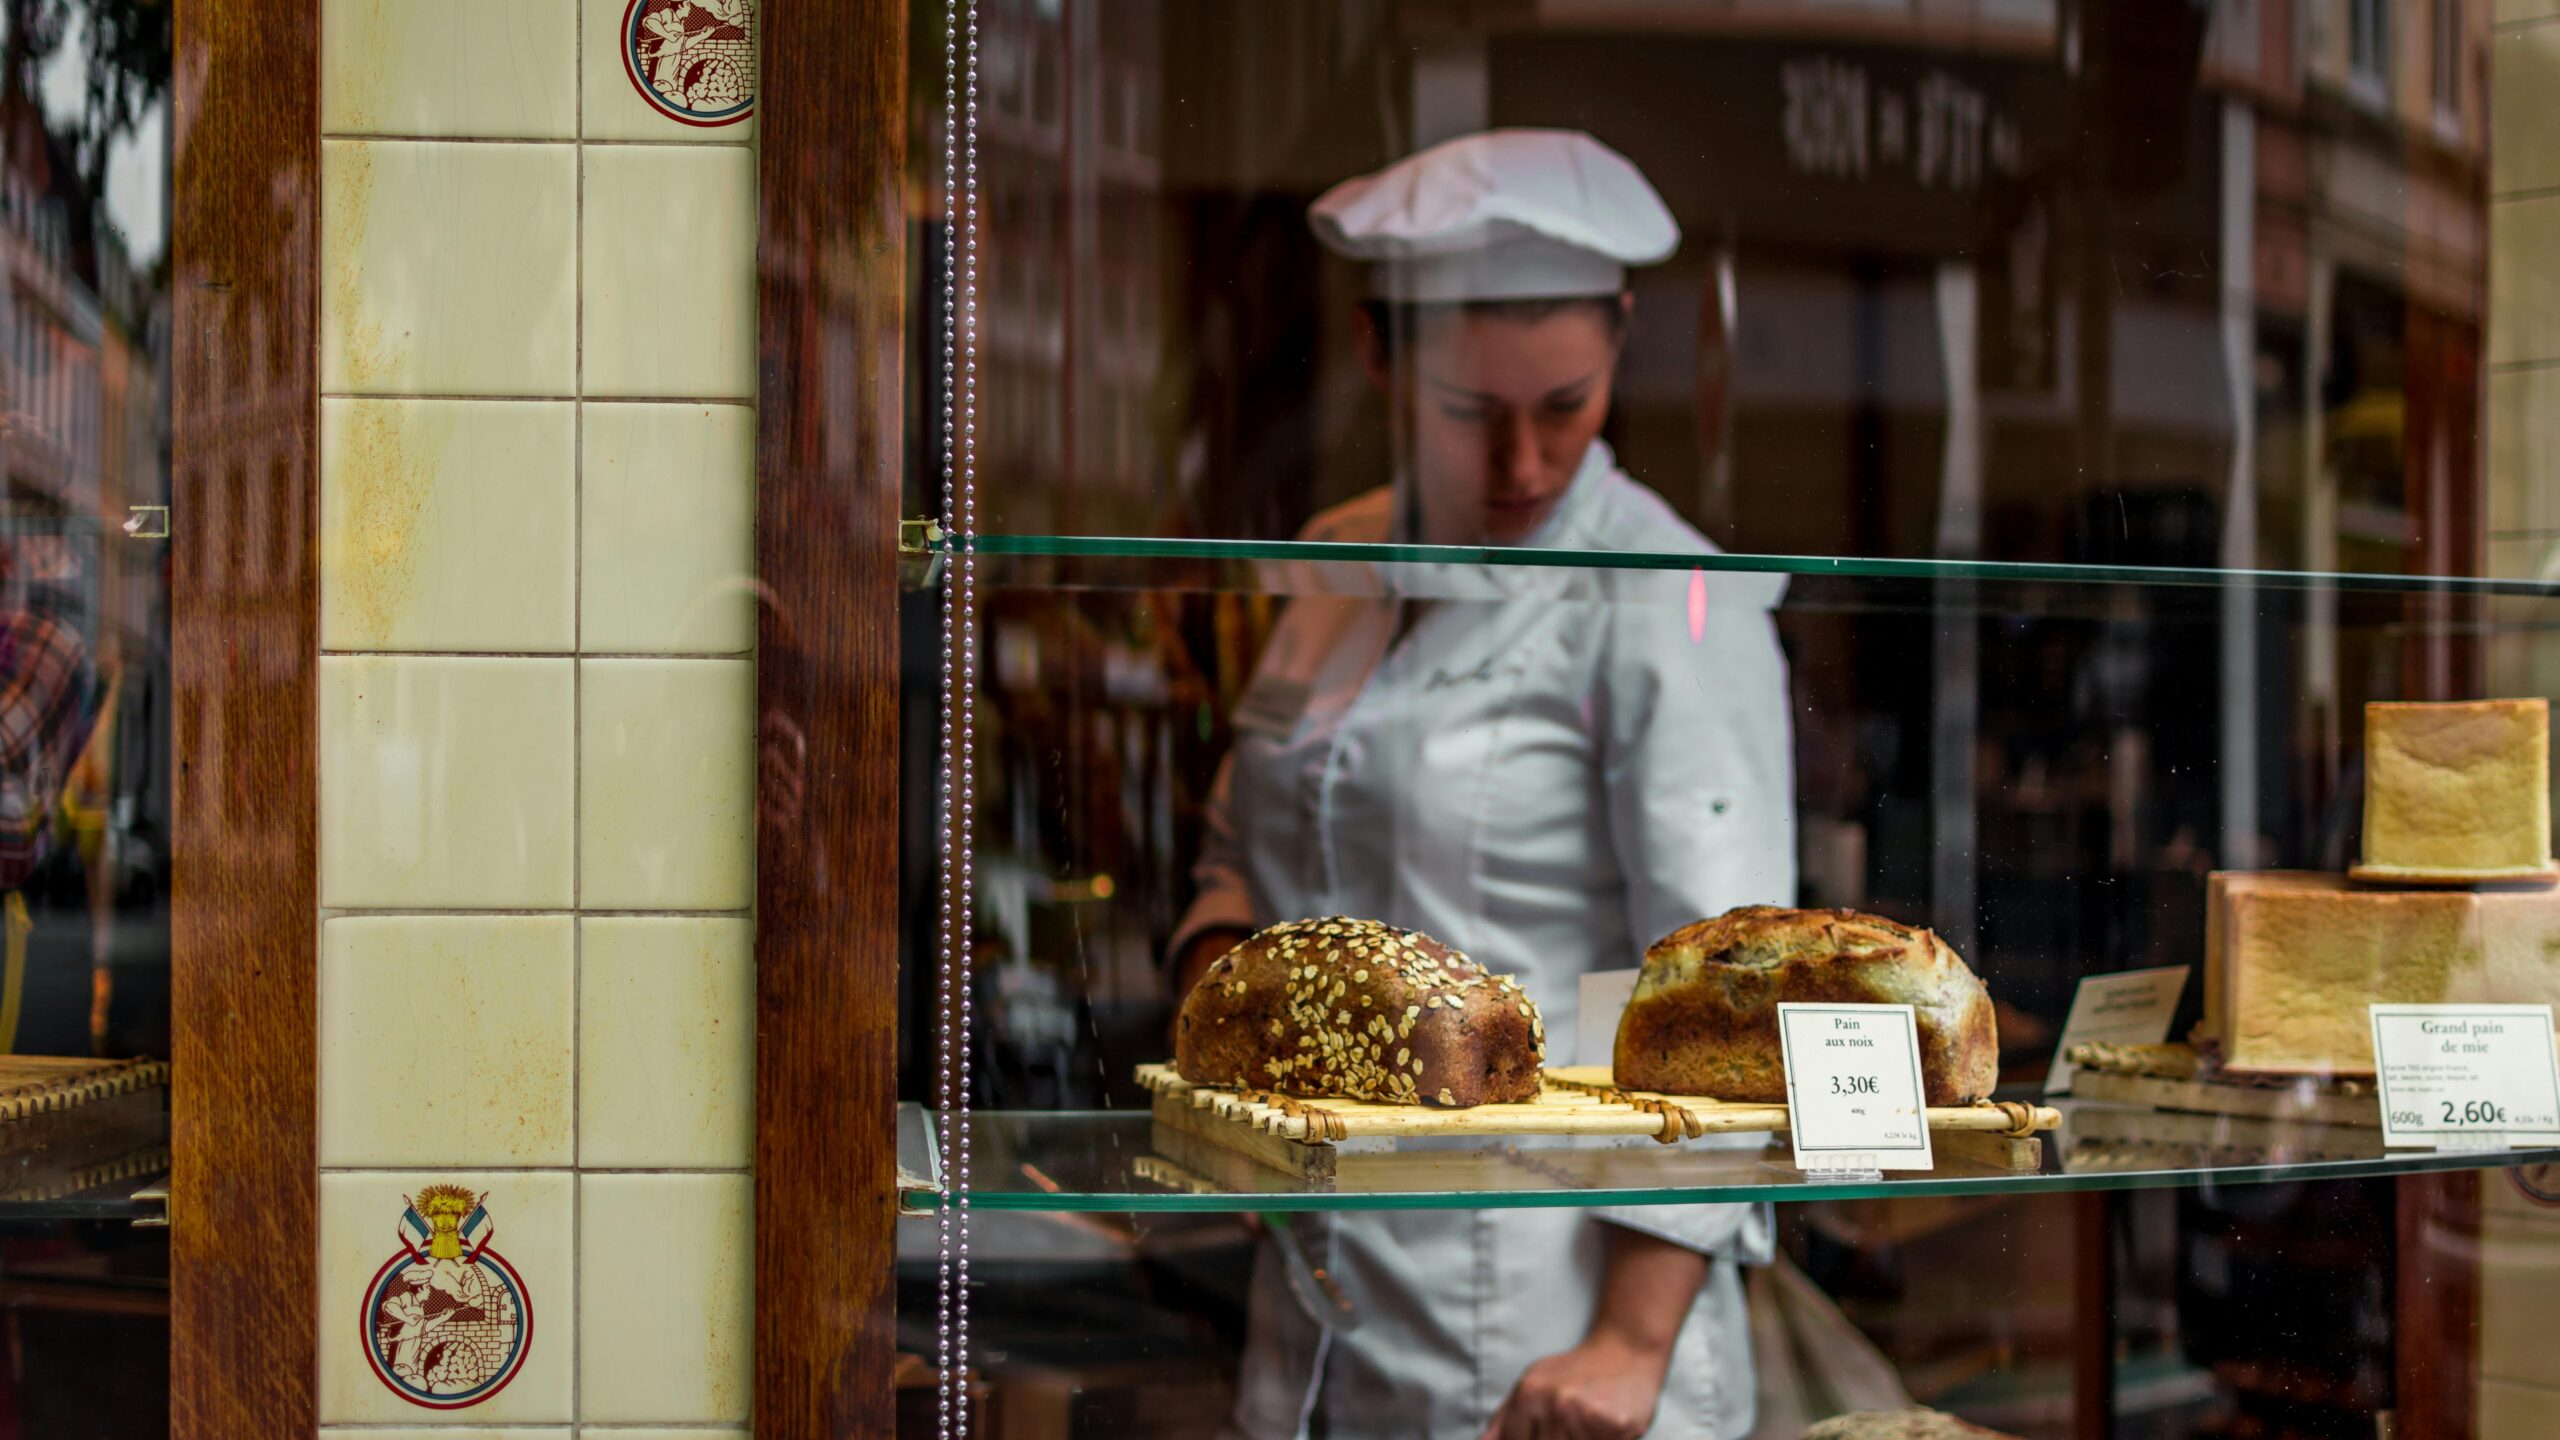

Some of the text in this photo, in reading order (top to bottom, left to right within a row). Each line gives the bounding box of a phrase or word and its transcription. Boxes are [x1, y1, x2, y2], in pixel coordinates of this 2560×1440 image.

[1834, 1018, 1861, 1030] Pain
[2421, 1020, 2504, 1037] Grand pain
[1825, 1035, 1874, 1047] aux noix
[2441, 1039, 2489, 1053] de mie
[1831, 1076, 1880, 1096] 3,30€
[2391, 1111, 2424, 1126] 600g
[2440, 1100, 2507, 1126] 2,60€
